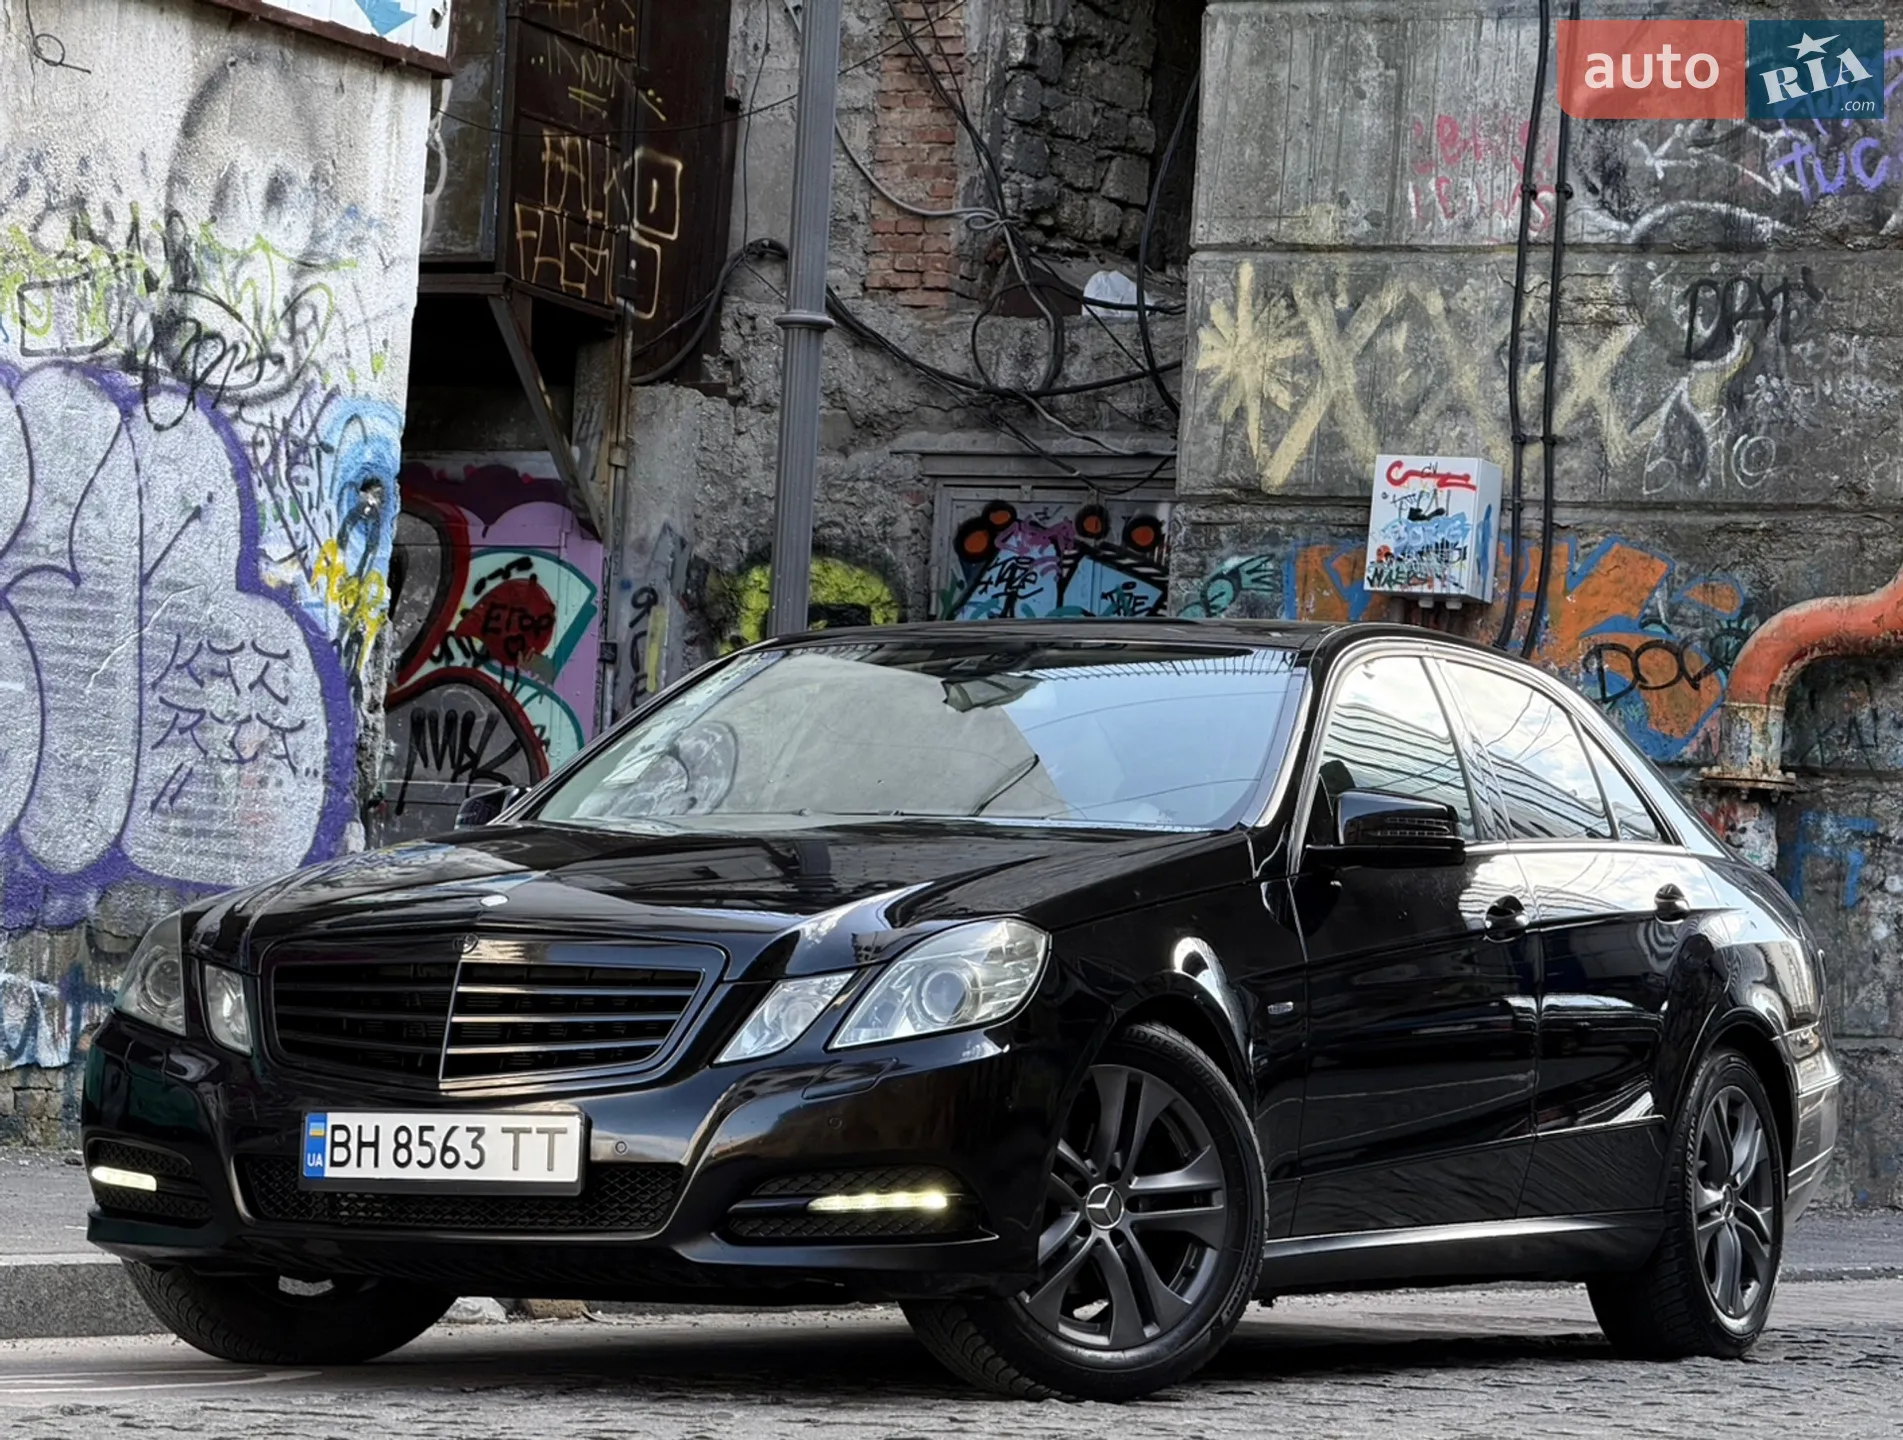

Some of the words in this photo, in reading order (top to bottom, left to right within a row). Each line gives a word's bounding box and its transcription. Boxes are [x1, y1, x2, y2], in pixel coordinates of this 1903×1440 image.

[307, 1153, 323, 1168] UA
[329, 1124, 380, 1168] BH
[392, 1125, 486, 1170] 8563
[501, 1126, 568, 1172] TT
